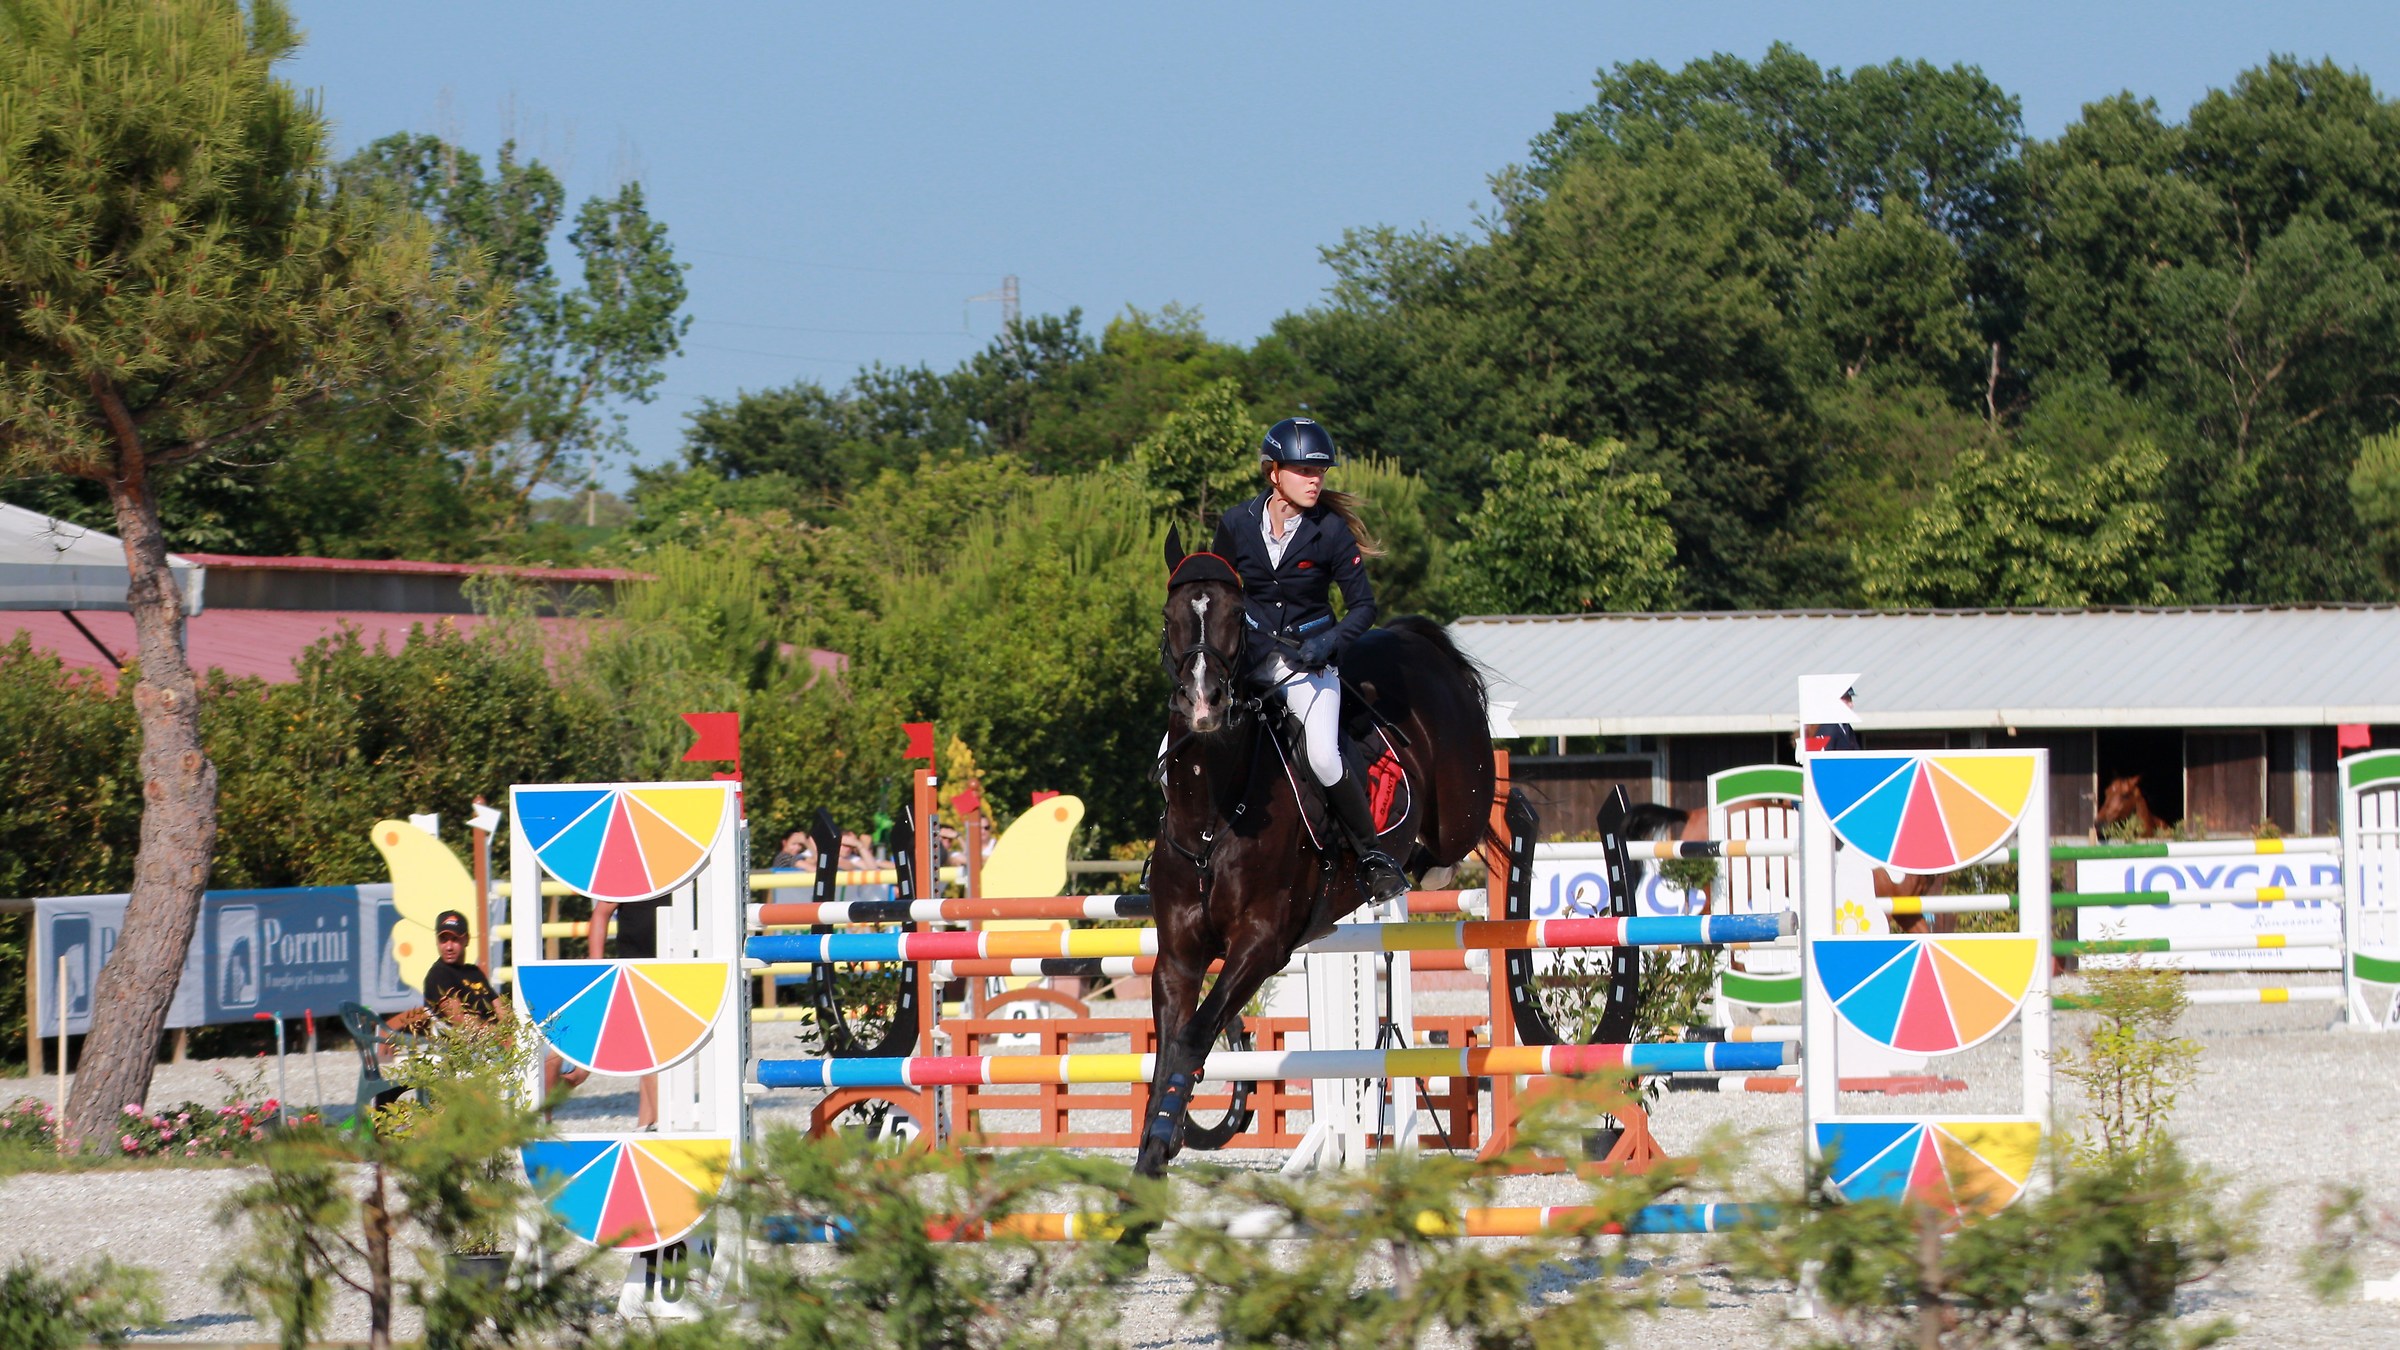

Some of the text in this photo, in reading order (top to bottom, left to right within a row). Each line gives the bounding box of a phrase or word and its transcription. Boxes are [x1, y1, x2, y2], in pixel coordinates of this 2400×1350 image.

[263, 915, 349, 966] Porrini
[891, 1116, 909, 1154] 5
[639, 1241, 687, 1303] 10
